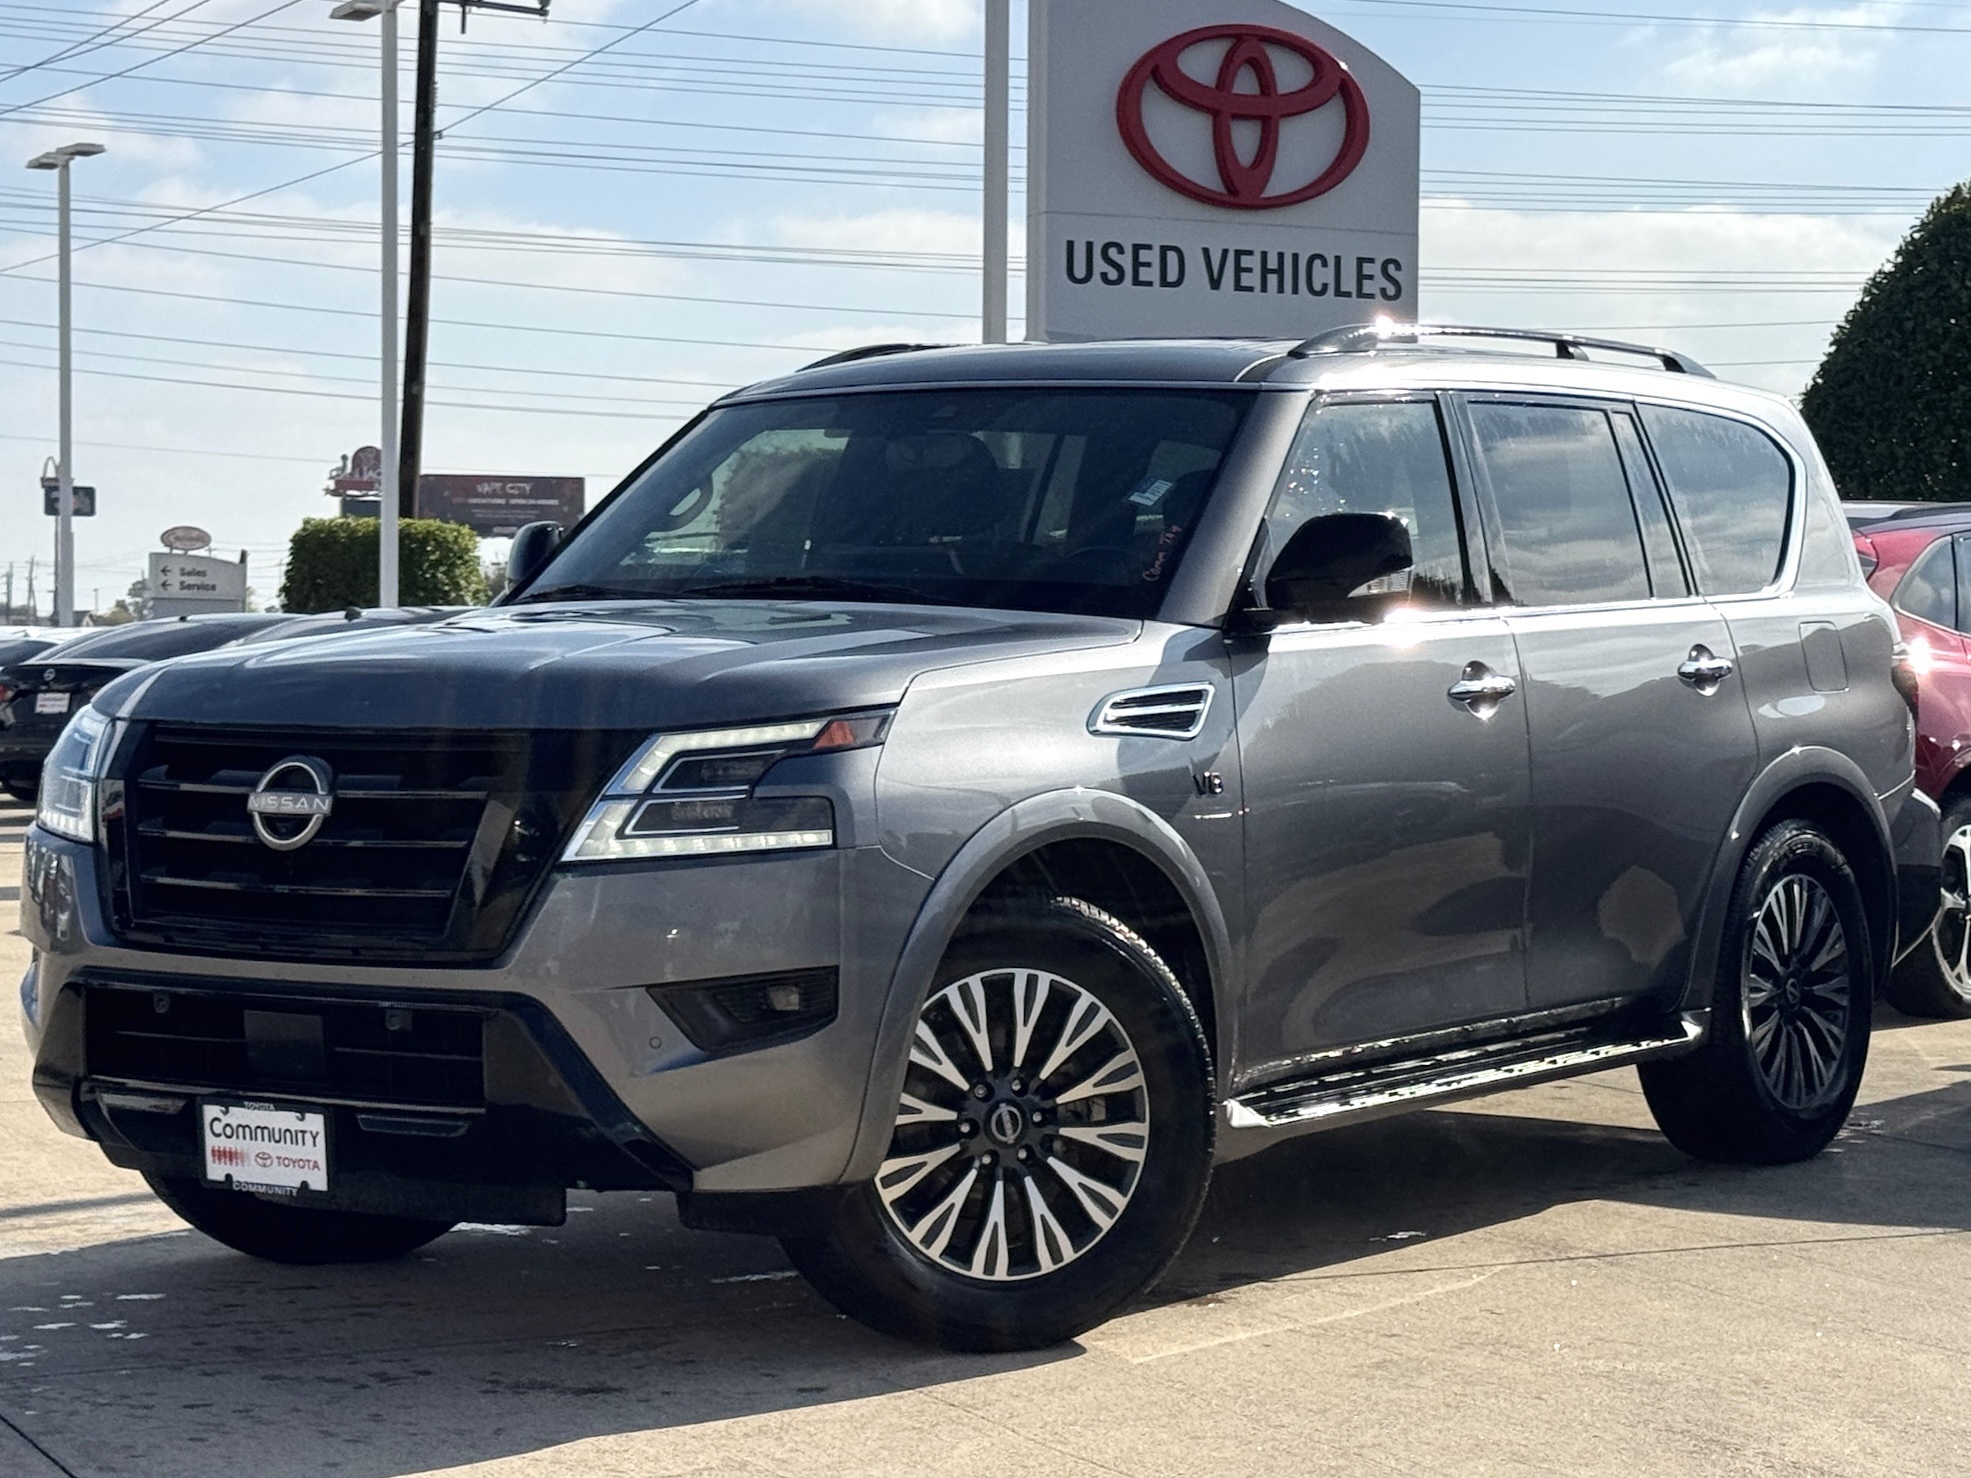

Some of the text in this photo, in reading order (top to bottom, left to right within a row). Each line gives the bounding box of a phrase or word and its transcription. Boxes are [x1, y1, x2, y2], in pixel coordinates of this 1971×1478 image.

[1066, 240, 1403, 302] USED VEHICLES
[506, 483, 532, 494] CITY
[179, 566, 207, 577] Sales
[179, 581, 216, 591] Service
[249, 795, 330, 812] NISSAN
[243, 1101, 276, 1112] TOYOTA
[275, 1155, 321, 1171] TOYOTA
[232, 1181, 298, 1197] COMMUNITY
